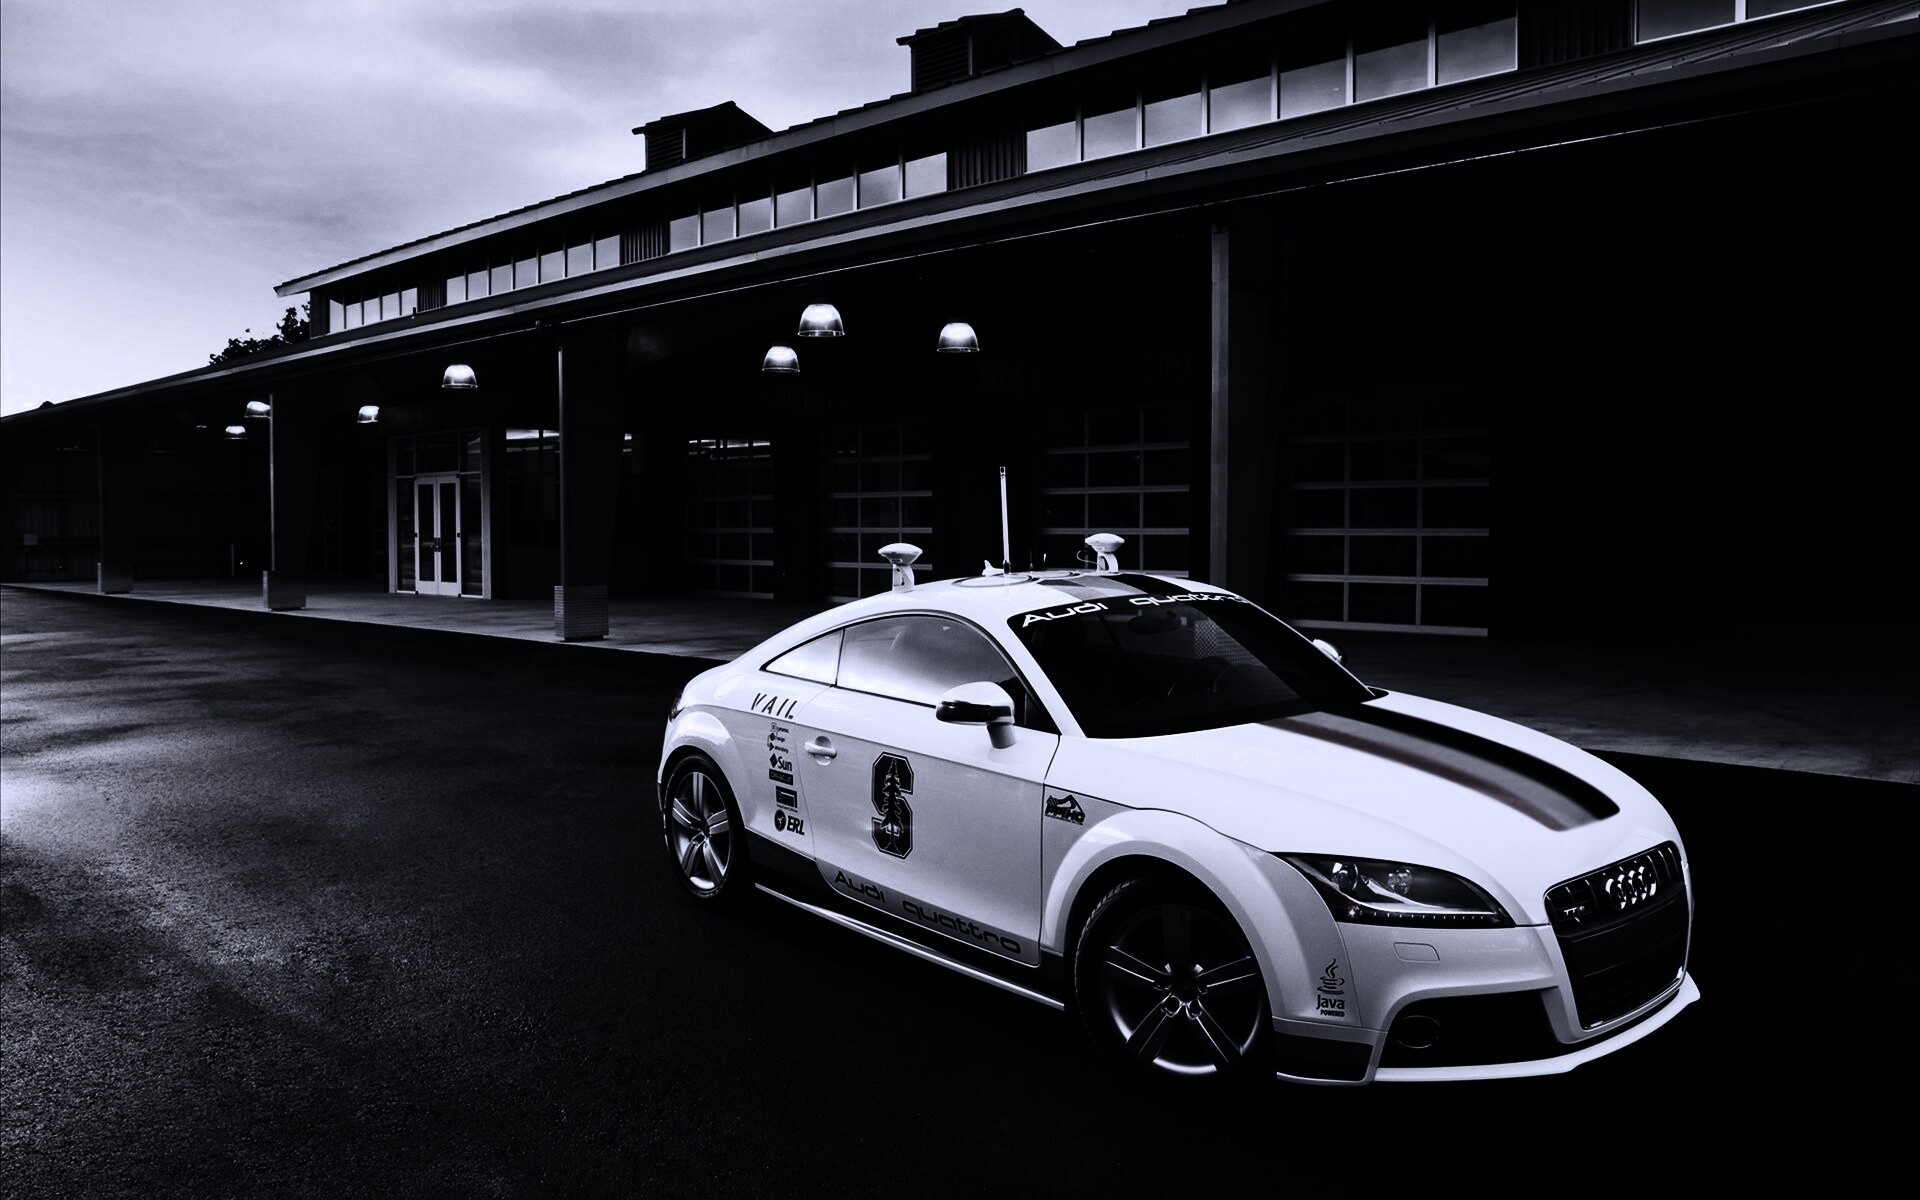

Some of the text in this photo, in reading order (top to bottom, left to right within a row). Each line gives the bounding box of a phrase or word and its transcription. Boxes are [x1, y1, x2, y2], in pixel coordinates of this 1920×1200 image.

[1022, 602, 1109, 628] Audi
[751, 692, 798, 720] VAIL
[778, 756, 792, 772] Sun
[787, 815, 805, 836] ERL
[834, 870, 1021, 954] Audi quattro
[1315, 994, 1345, 1011] Java
[1320, 1009, 1345, 1018] POWERED
